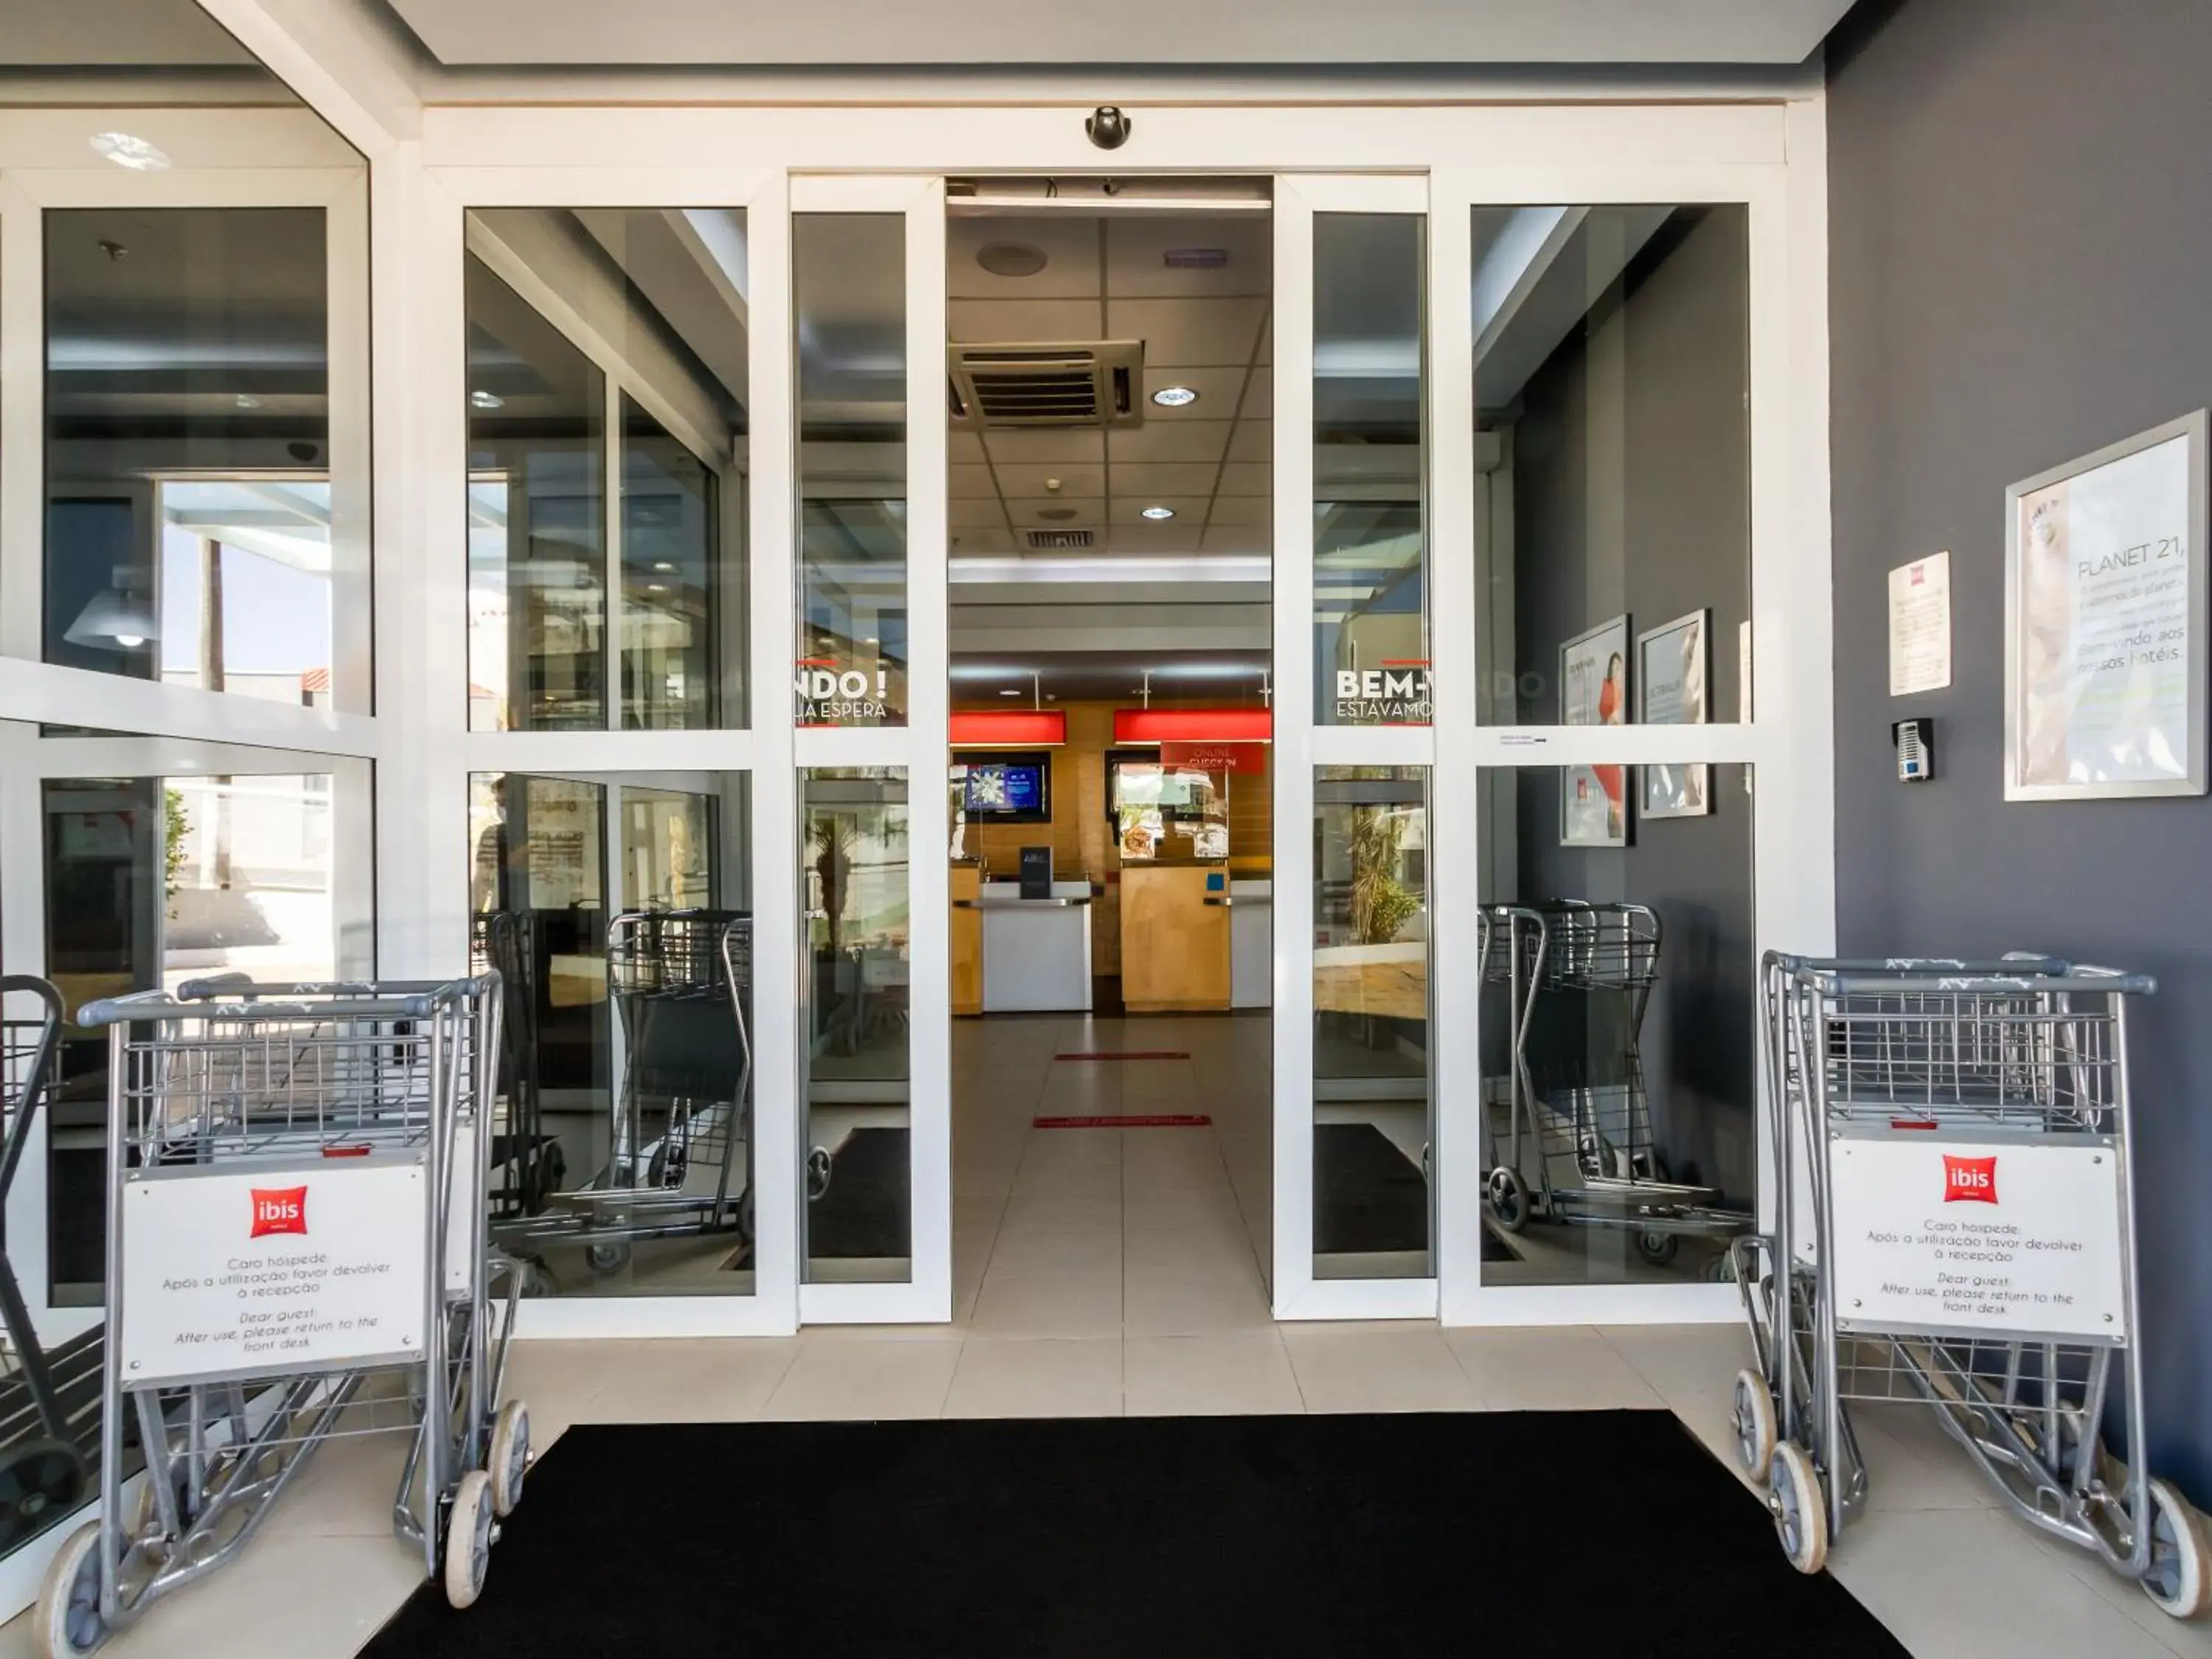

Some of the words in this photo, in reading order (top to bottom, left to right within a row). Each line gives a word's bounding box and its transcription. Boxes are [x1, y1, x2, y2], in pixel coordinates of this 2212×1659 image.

[2078, 543, 2151, 580] PLANET
[2157, 536, 2185, 559] 21,
[821, 703, 886, 718] ESPERA
[1951, 1168, 1989, 1188] ibis
[259, 1200, 299, 1221] ibis
[1924, 1219, 1957, 1232] Caro
[1867, 1230, 1899, 1244] Após
[1903, 1235, 1912, 1243] a
[1986, 1237, 2020, 1248] favor
[2025, 1239, 2082, 1251] devolver
[228, 1258, 262, 1270] Caro
[162, 1278, 199, 1290] Após
[204, 1278, 213, 1287] a
[293, 1268, 327, 1280] favor
[333, 1263, 390, 1277] devolver
[1937, 1272, 1968, 1284] Dear
[1881, 1281, 1910, 1295] After
[1942, 1287, 1985, 1299] please
[1989, 1291, 2028, 1301] return
[2034, 1293, 2048, 1303] to
[2053, 1294, 2073, 1304] the
[1943, 1302, 1972, 1312] front
[240, 1312, 271, 1324] Dear
[175, 1332, 208, 1344] After
[243, 1327, 290, 1340] please
[294, 1322, 333, 1333] return
[338, 1320, 352, 1329] to
[357, 1316, 378, 1328] the
[243, 1341, 274, 1352] front
